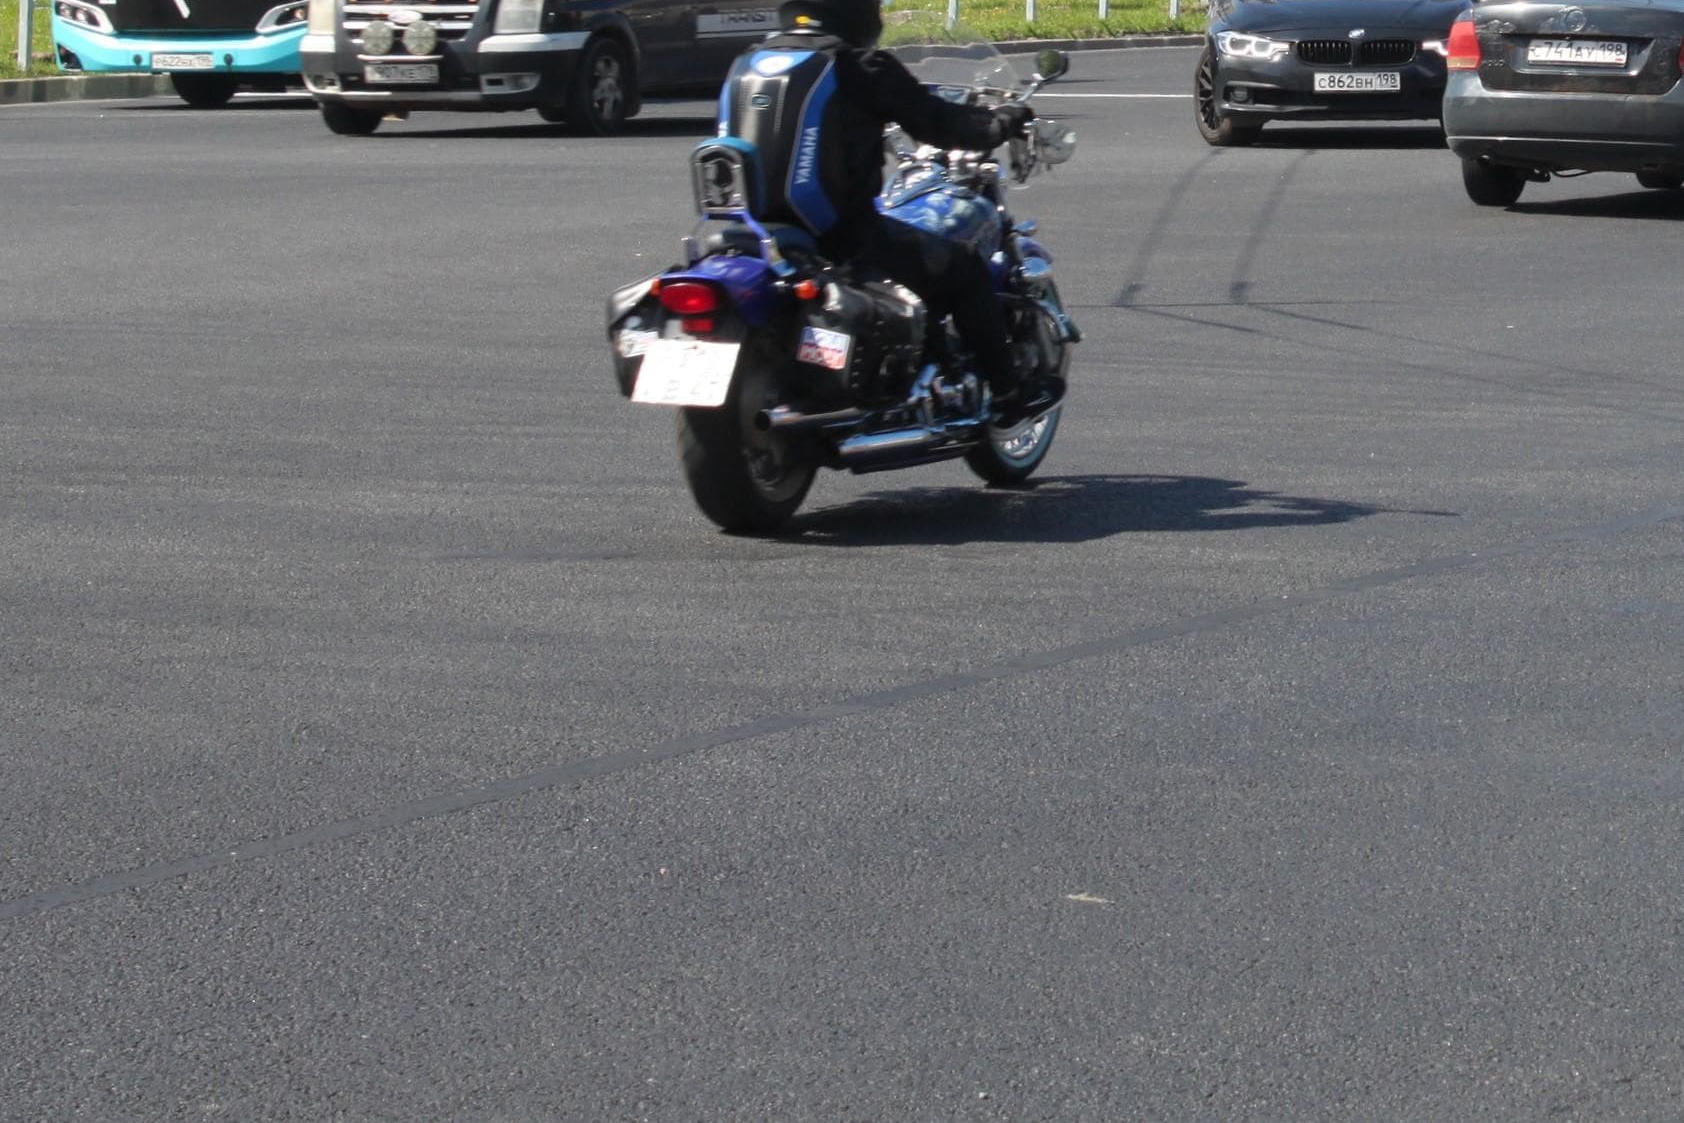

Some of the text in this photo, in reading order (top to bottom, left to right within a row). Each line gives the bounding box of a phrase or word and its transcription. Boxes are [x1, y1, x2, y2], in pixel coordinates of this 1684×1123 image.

[1599, 42, 1623, 57] 198
[1318, 73, 1398, 89] С862ВН 198
[793, 126, 818, 185] YAMAHA
